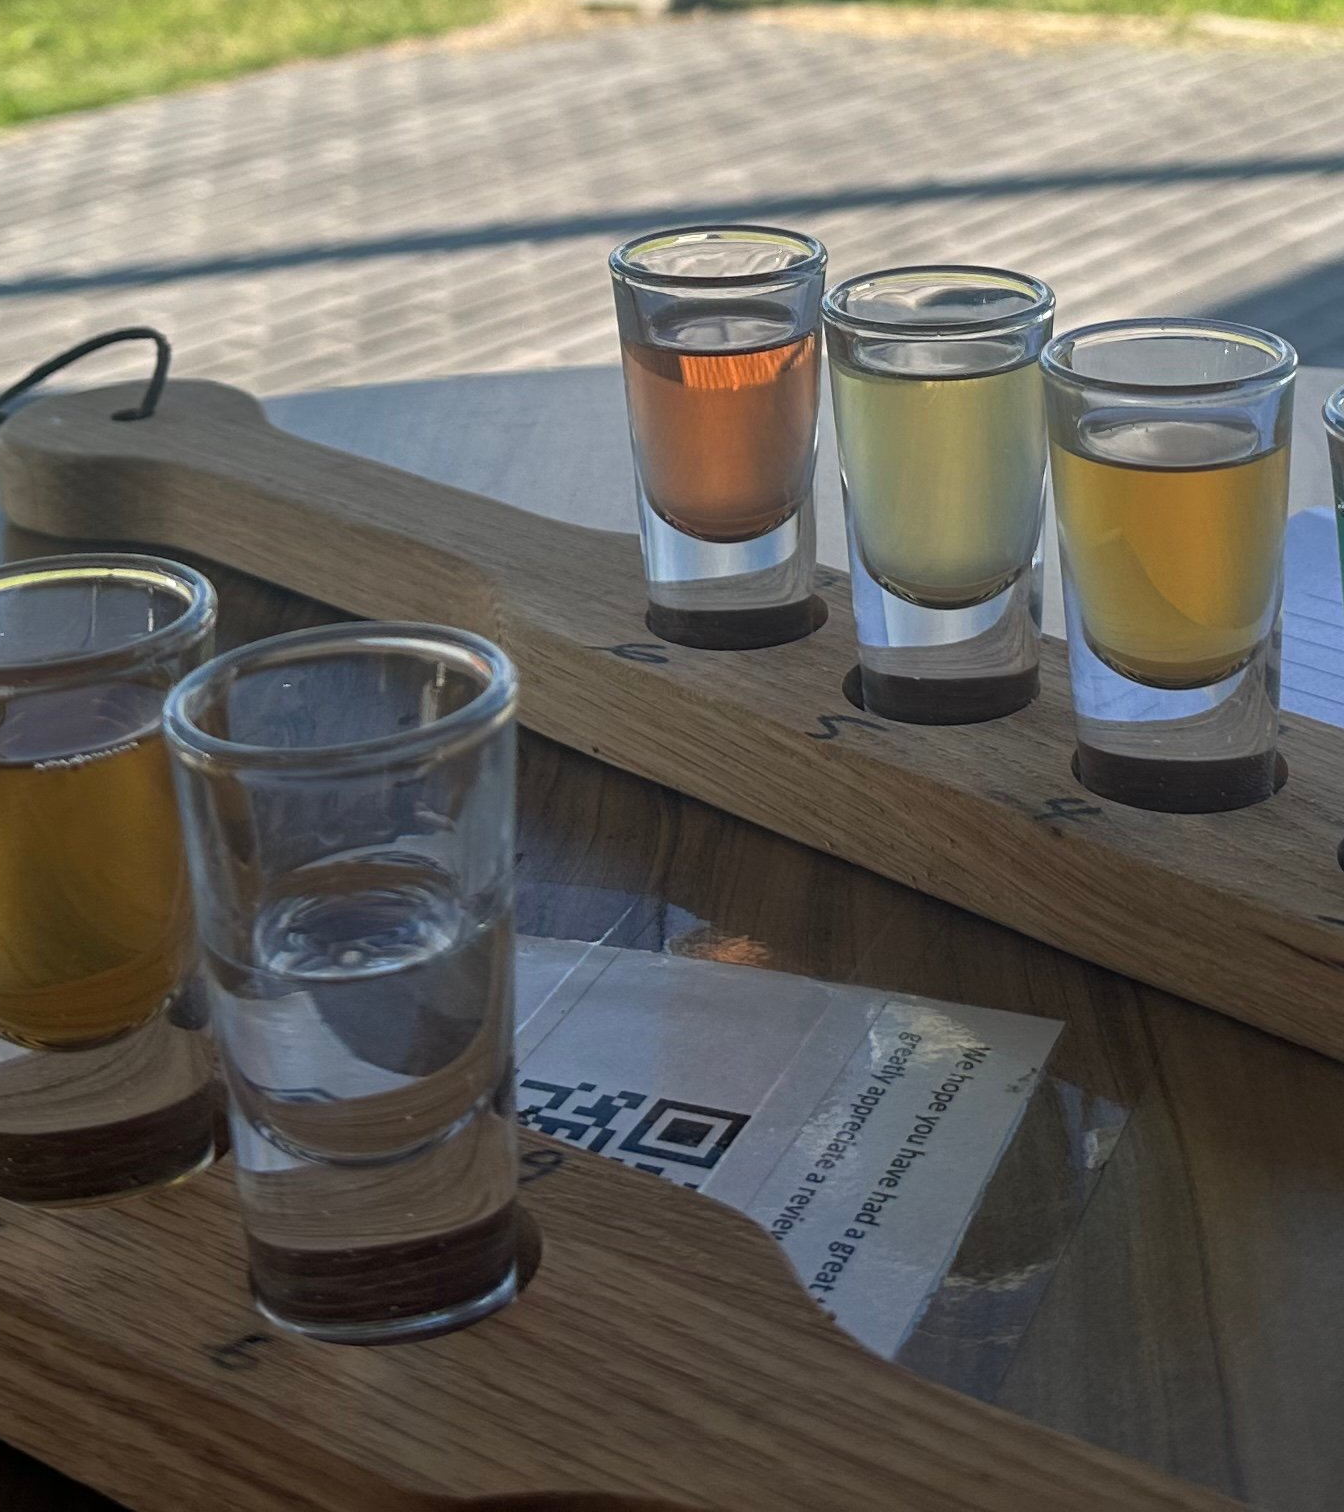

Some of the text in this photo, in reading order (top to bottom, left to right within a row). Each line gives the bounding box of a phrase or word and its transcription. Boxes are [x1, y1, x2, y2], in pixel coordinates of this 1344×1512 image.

[804, 714, 890, 739] 5
[871, 1032, 922, 1085] greatly
[815, 1086, 886, 1170] appreciate
[806, 1172, 826, 1184] a
[809, 1044, 992, 1292] We hope you have had a great
